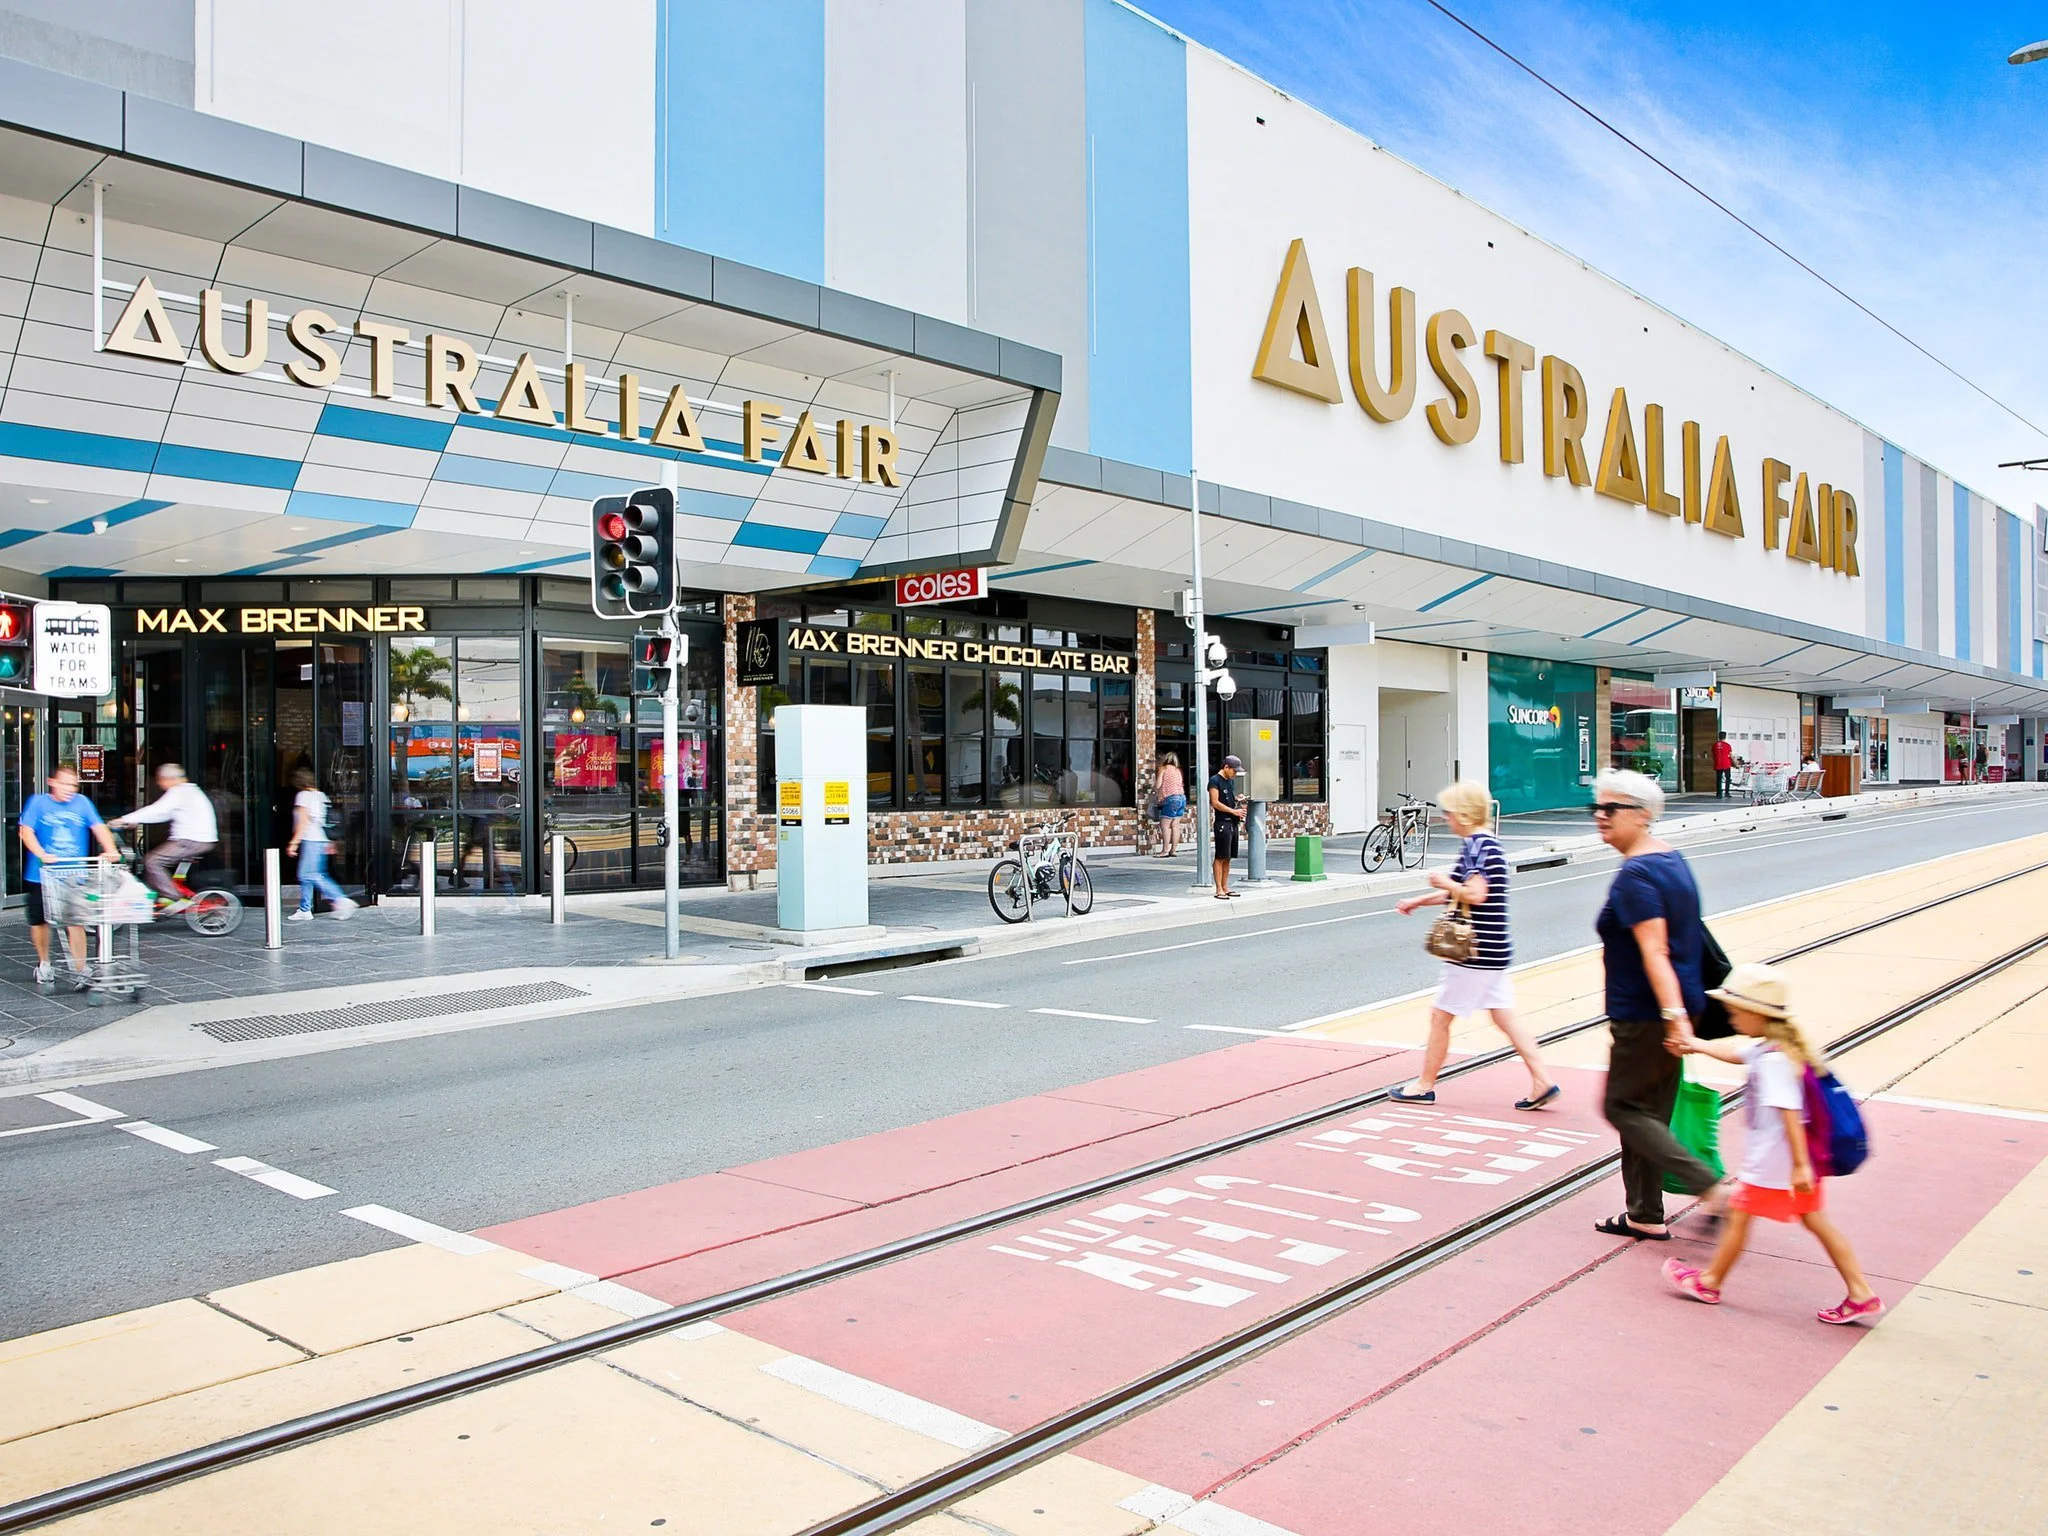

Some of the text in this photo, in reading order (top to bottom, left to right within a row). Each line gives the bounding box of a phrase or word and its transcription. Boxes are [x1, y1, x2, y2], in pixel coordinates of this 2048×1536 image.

[102, 275, 901, 488] AUSTRALIA FAIR
[1252, 238, 1860, 577] AUSTRALIA FAIR
[903, 572, 972, 602] coles
[137, 606, 426, 634] MAX BRENNER
[50, 641, 97, 655] WATCH
[847, 633, 958, 662] BRENNER
[963, 642, 1086, 672] CHOCOLATE
[1090, 653, 1130, 675] BAR
[59, 658, 87, 672] FOR
[50, 676, 98, 689] TRAMS
[1686, 686, 1709, 698] SUNCORP
[1508, 704, 1548, 726] SUNCORP
[986, 1107, 1600, 1310] KEEP CLEAR
